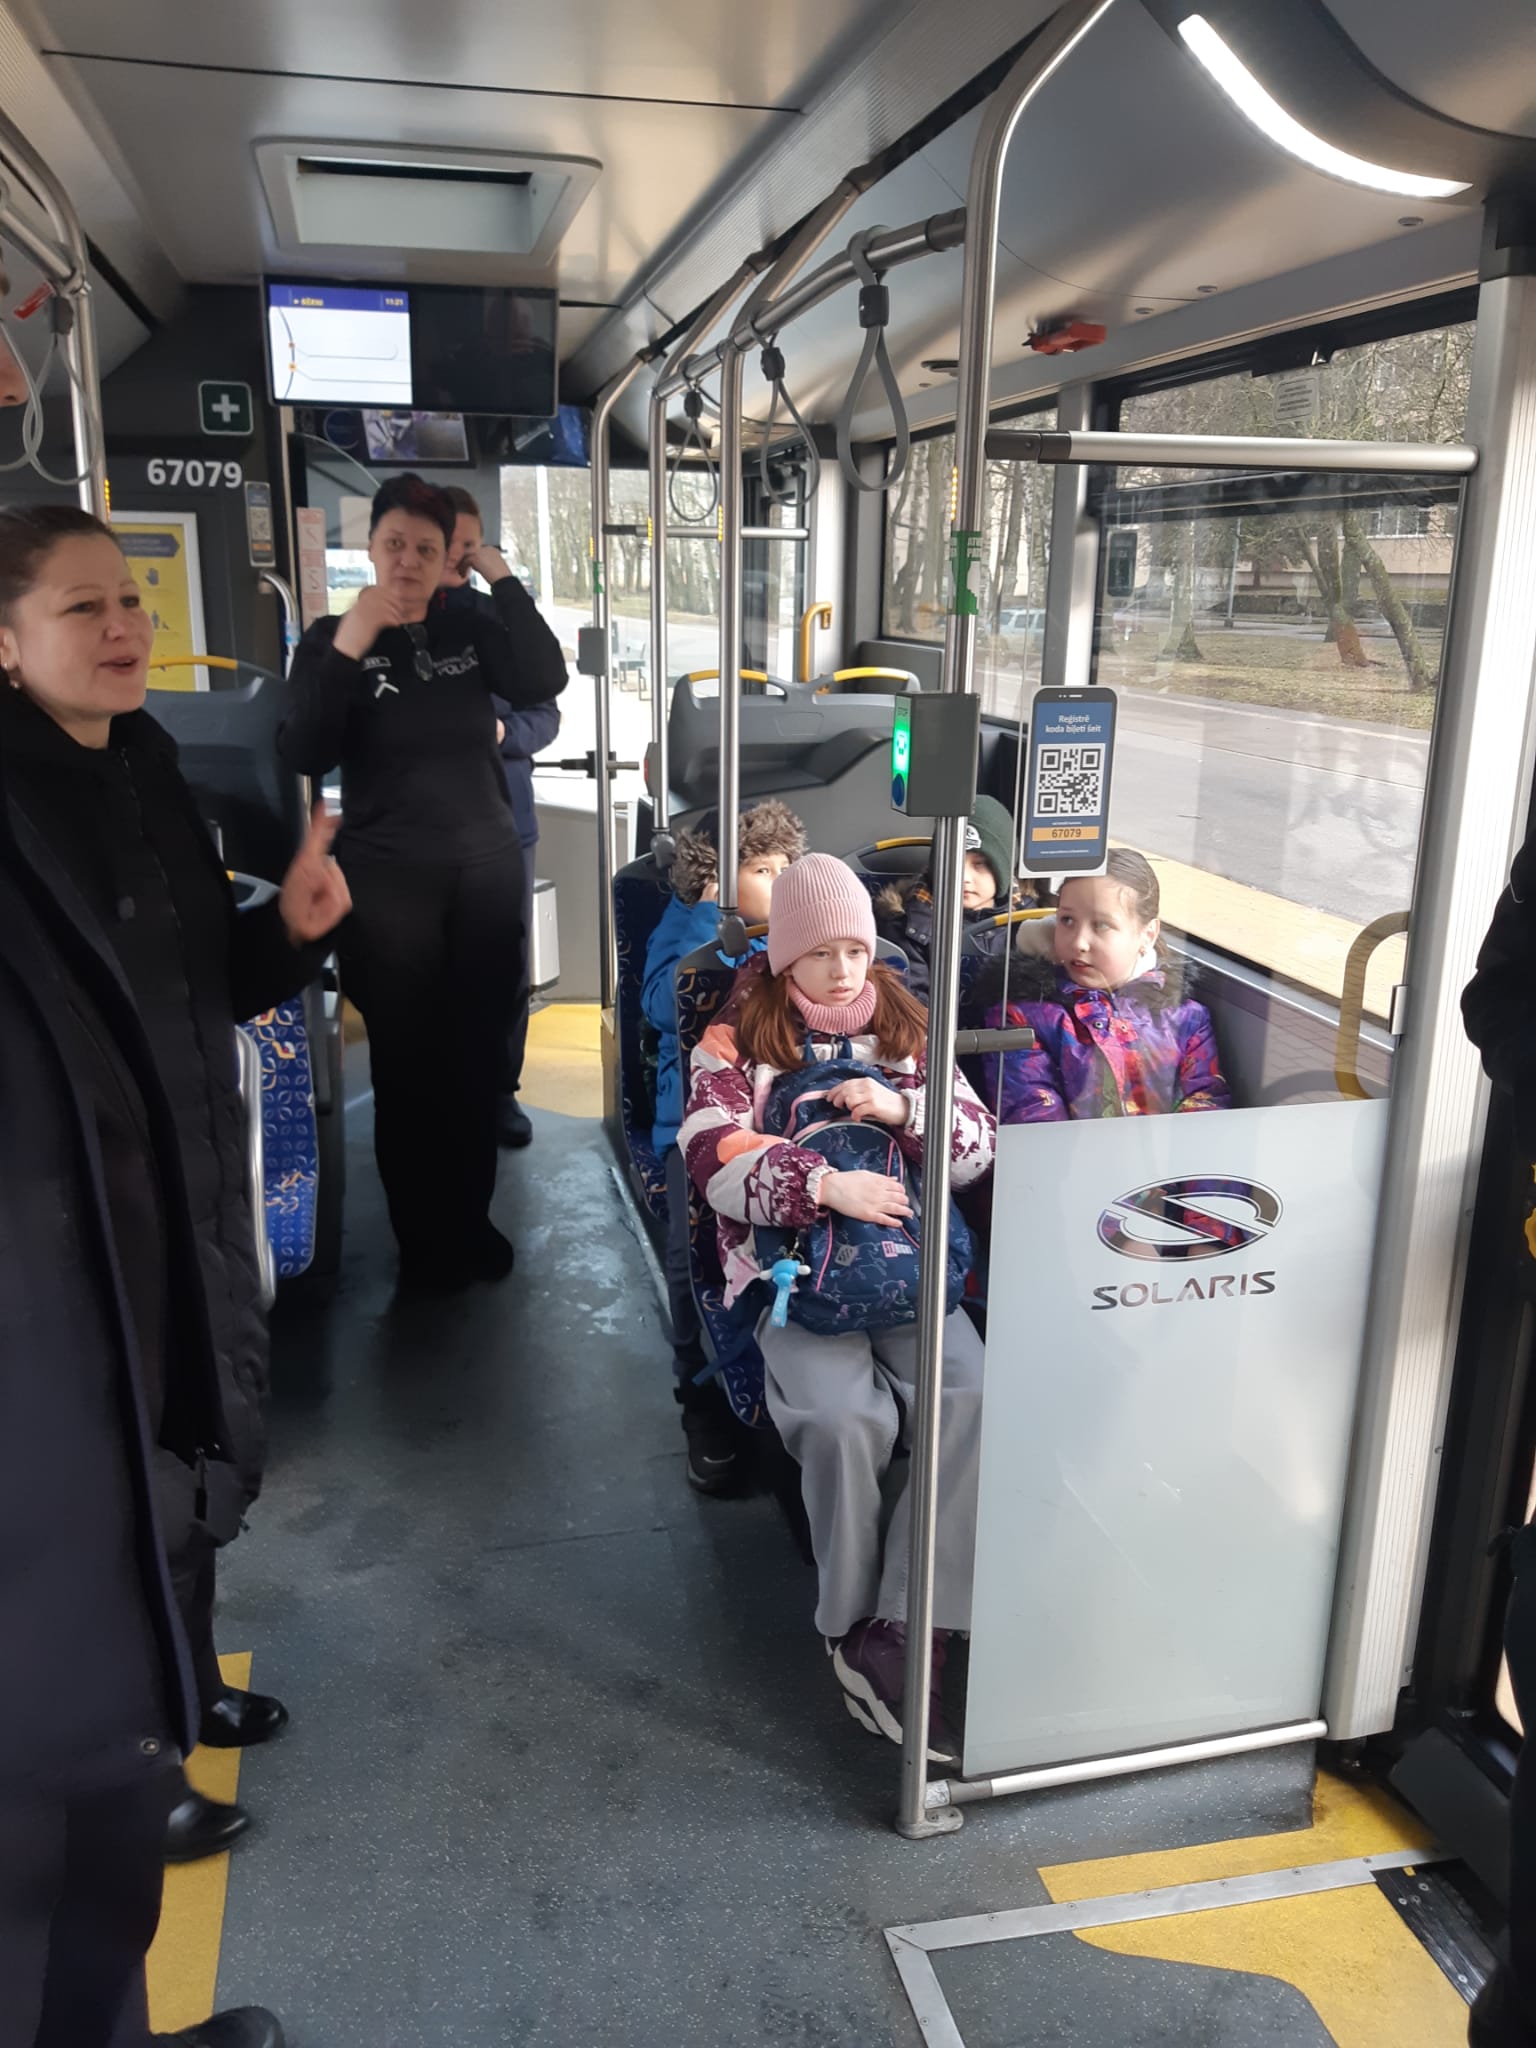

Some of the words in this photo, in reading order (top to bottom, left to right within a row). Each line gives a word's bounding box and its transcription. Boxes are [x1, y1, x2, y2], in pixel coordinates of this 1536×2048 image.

[147, 459, 242, 488] 67079
[1045, 724, 1065, 733] koda
[1051, 828, 1082, 838] 67079
[1091, 1270, 1276, 1310] SOLARIS
